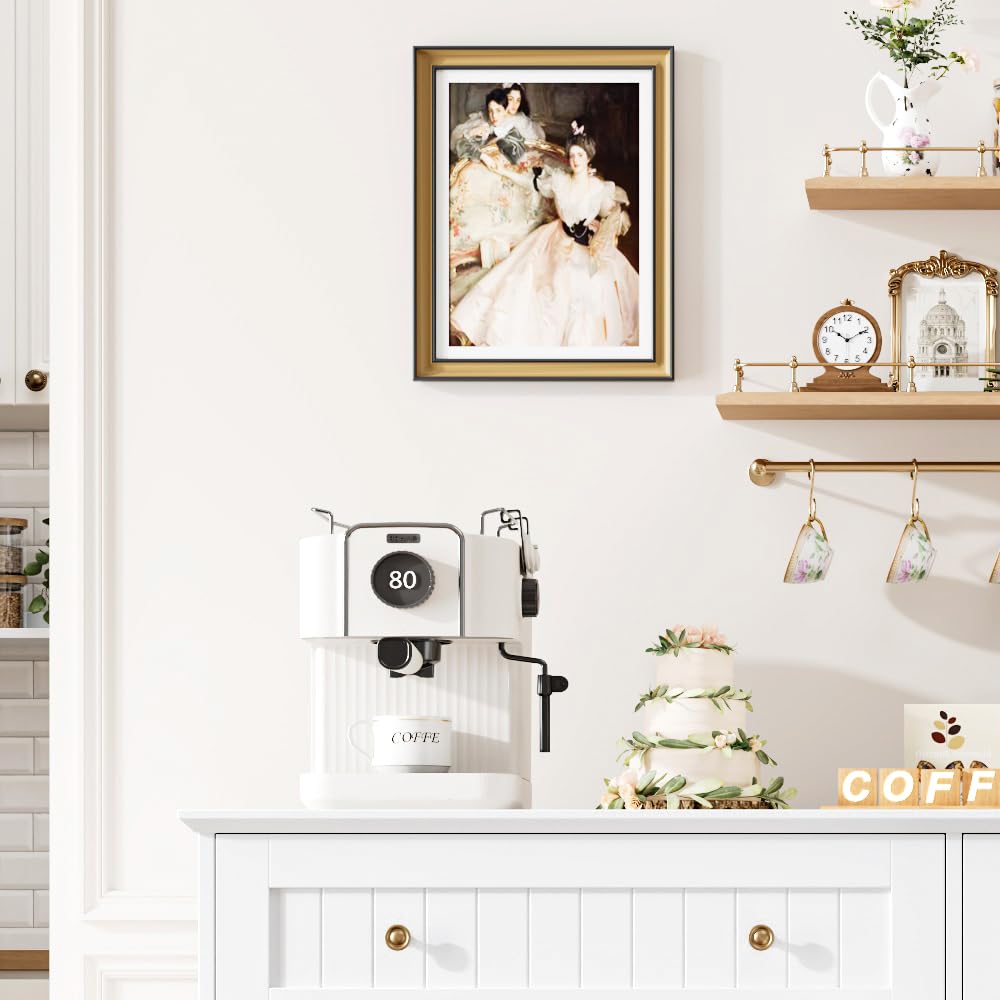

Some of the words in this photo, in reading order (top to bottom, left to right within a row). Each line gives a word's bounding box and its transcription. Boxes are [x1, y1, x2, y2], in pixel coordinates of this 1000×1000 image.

[832, 317, 841, 325] 11
[843, 314, 852, 322] 12
[824, 325, 834, 333] 10
[863, 326, 869, 334] 2
[822, 336, 828, 344] 9
[867, 336, 872, 344] 3
[834, 354, 839, 362] 7
[854, 354, 861, 362] 5
[388, 570, 417, 590] 80
[391, 731, 440, 744] COFFE
